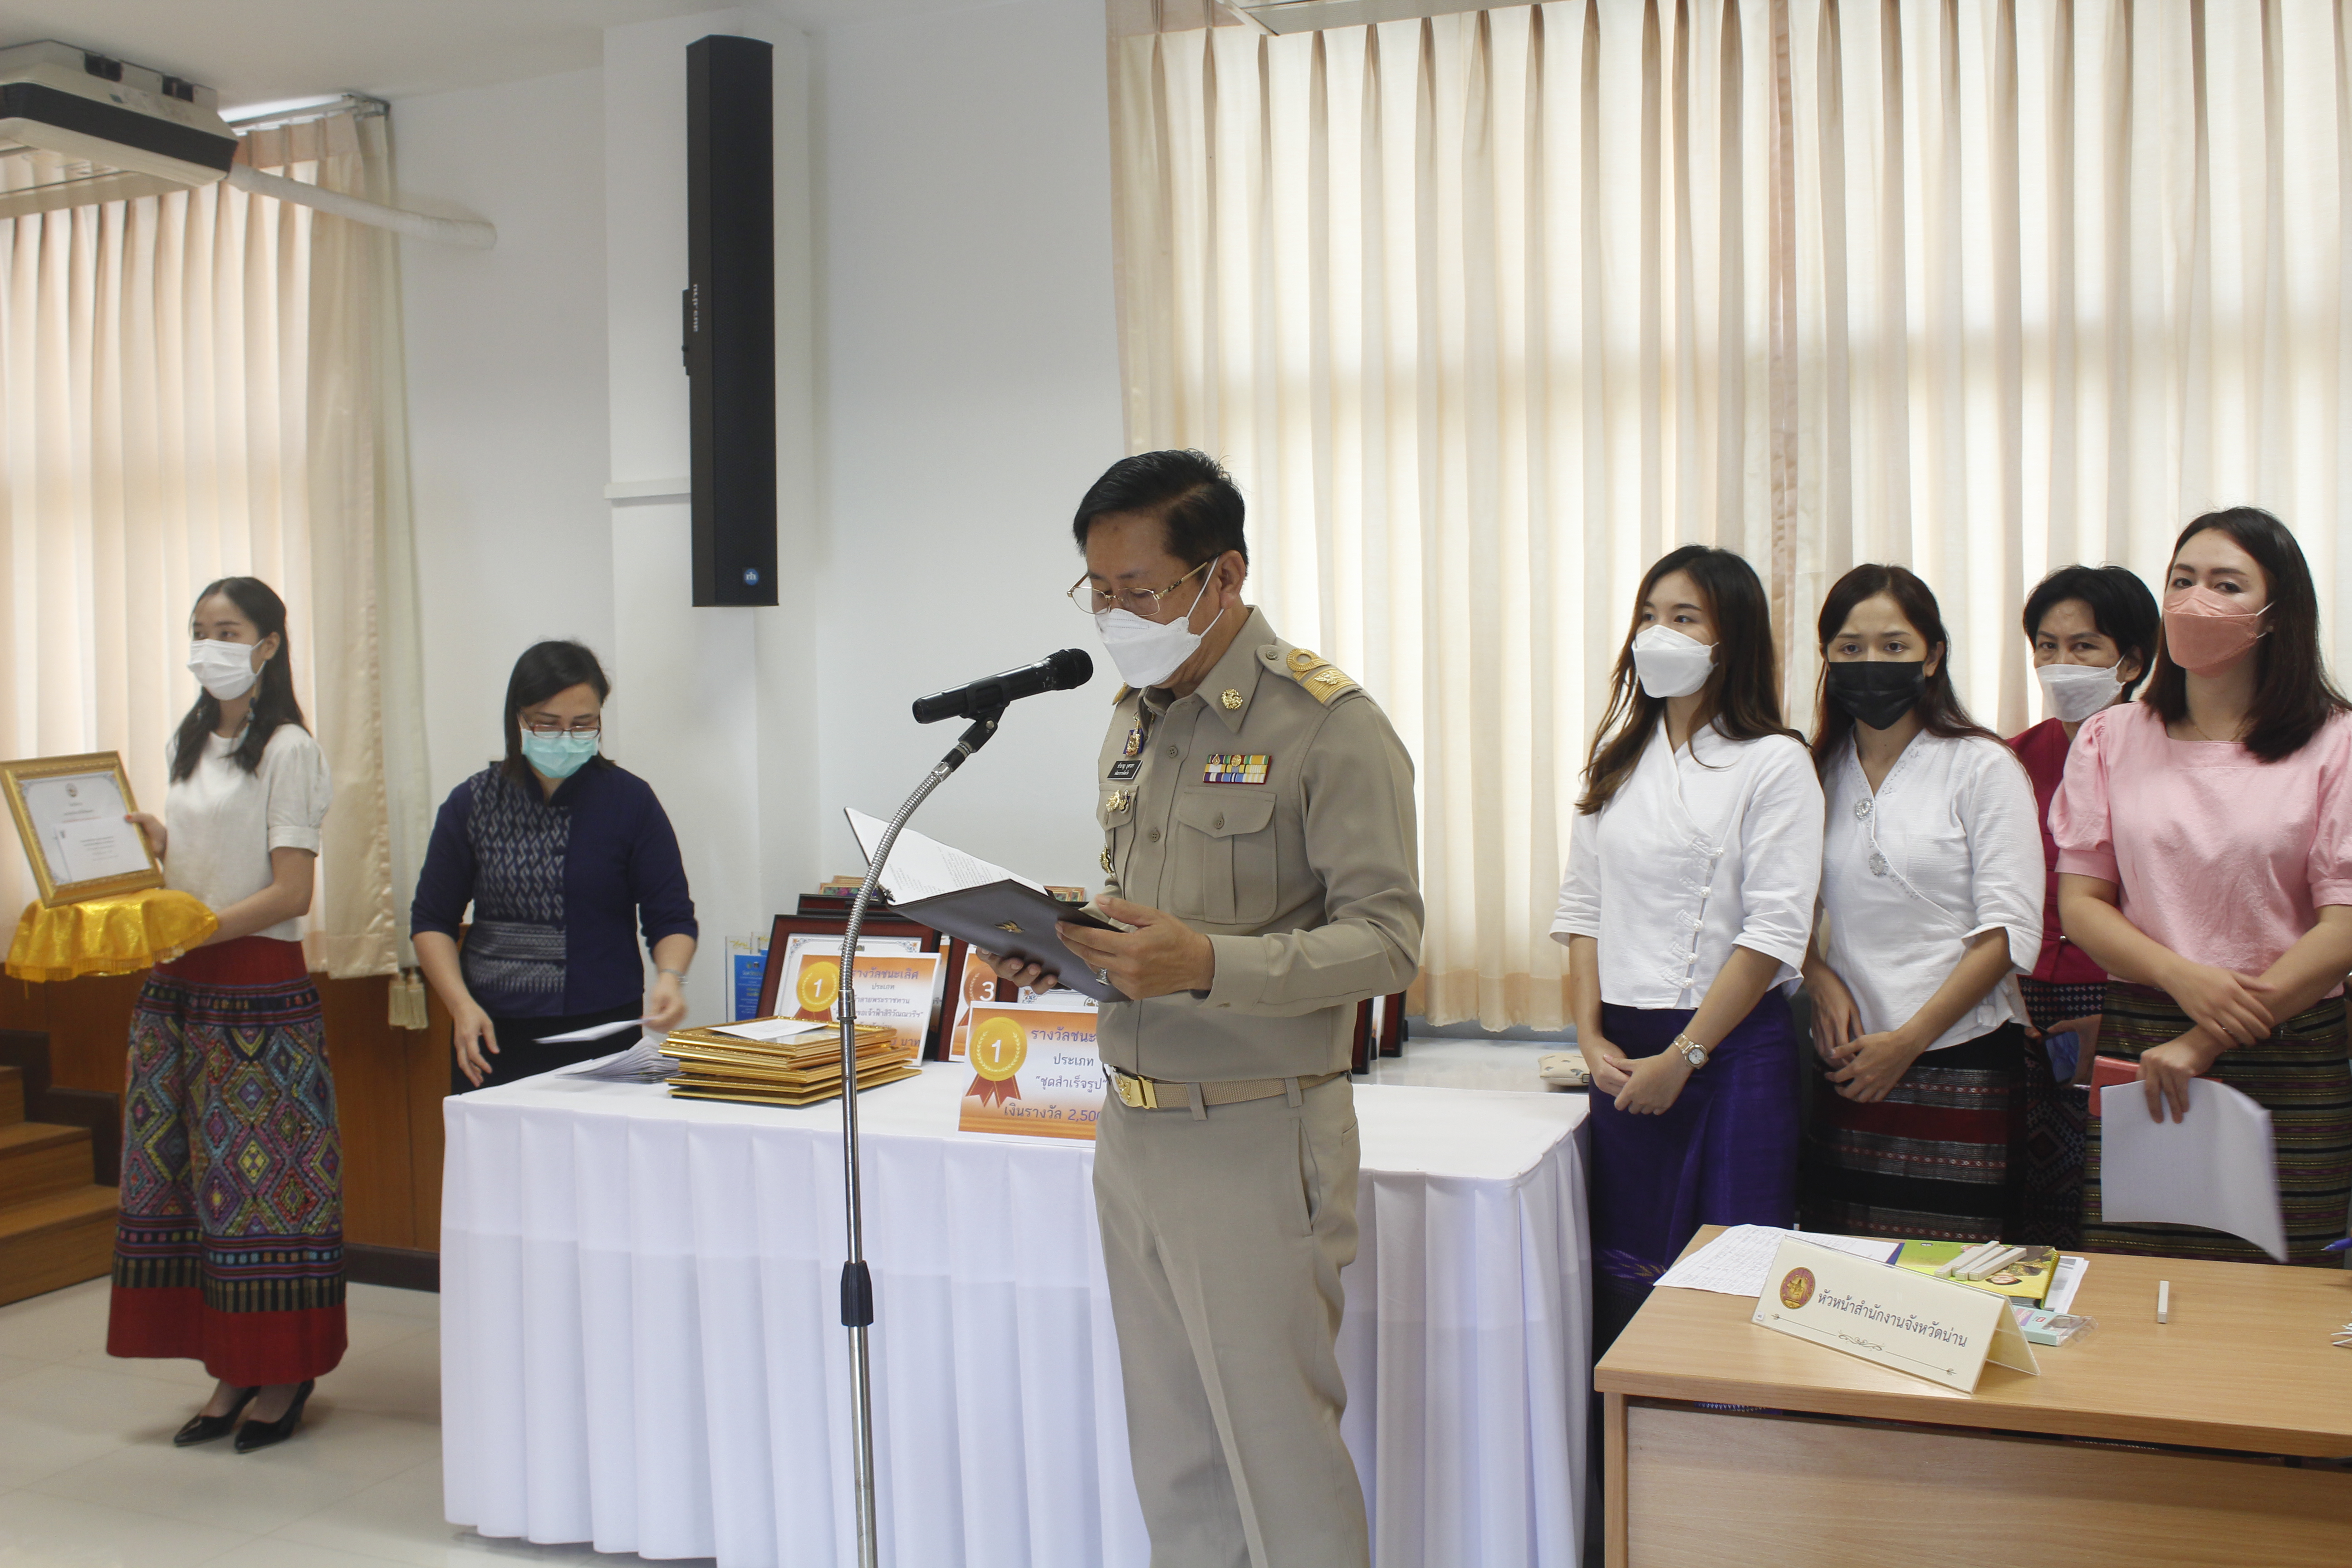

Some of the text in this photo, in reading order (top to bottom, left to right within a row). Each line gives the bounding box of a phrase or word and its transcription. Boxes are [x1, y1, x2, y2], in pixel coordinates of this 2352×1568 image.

[813, 979, 822, 998] 1
[980, 981, 995, 1001] 3
[854, 995, 910, 1004] ้าลายพระราชทาน
[1031, 1026, 1097, 1042] รางวัลชนะ
[991, 1039, 1002, 1063] 1
[1053, 1053, 1094, 1067] ประเภท
[1004, 1102, 1062, 1119] เงินรางวัล
[1817, 1289, 1968, 1348] หัวหน้าสำนักงานจังหวัดน่าน
